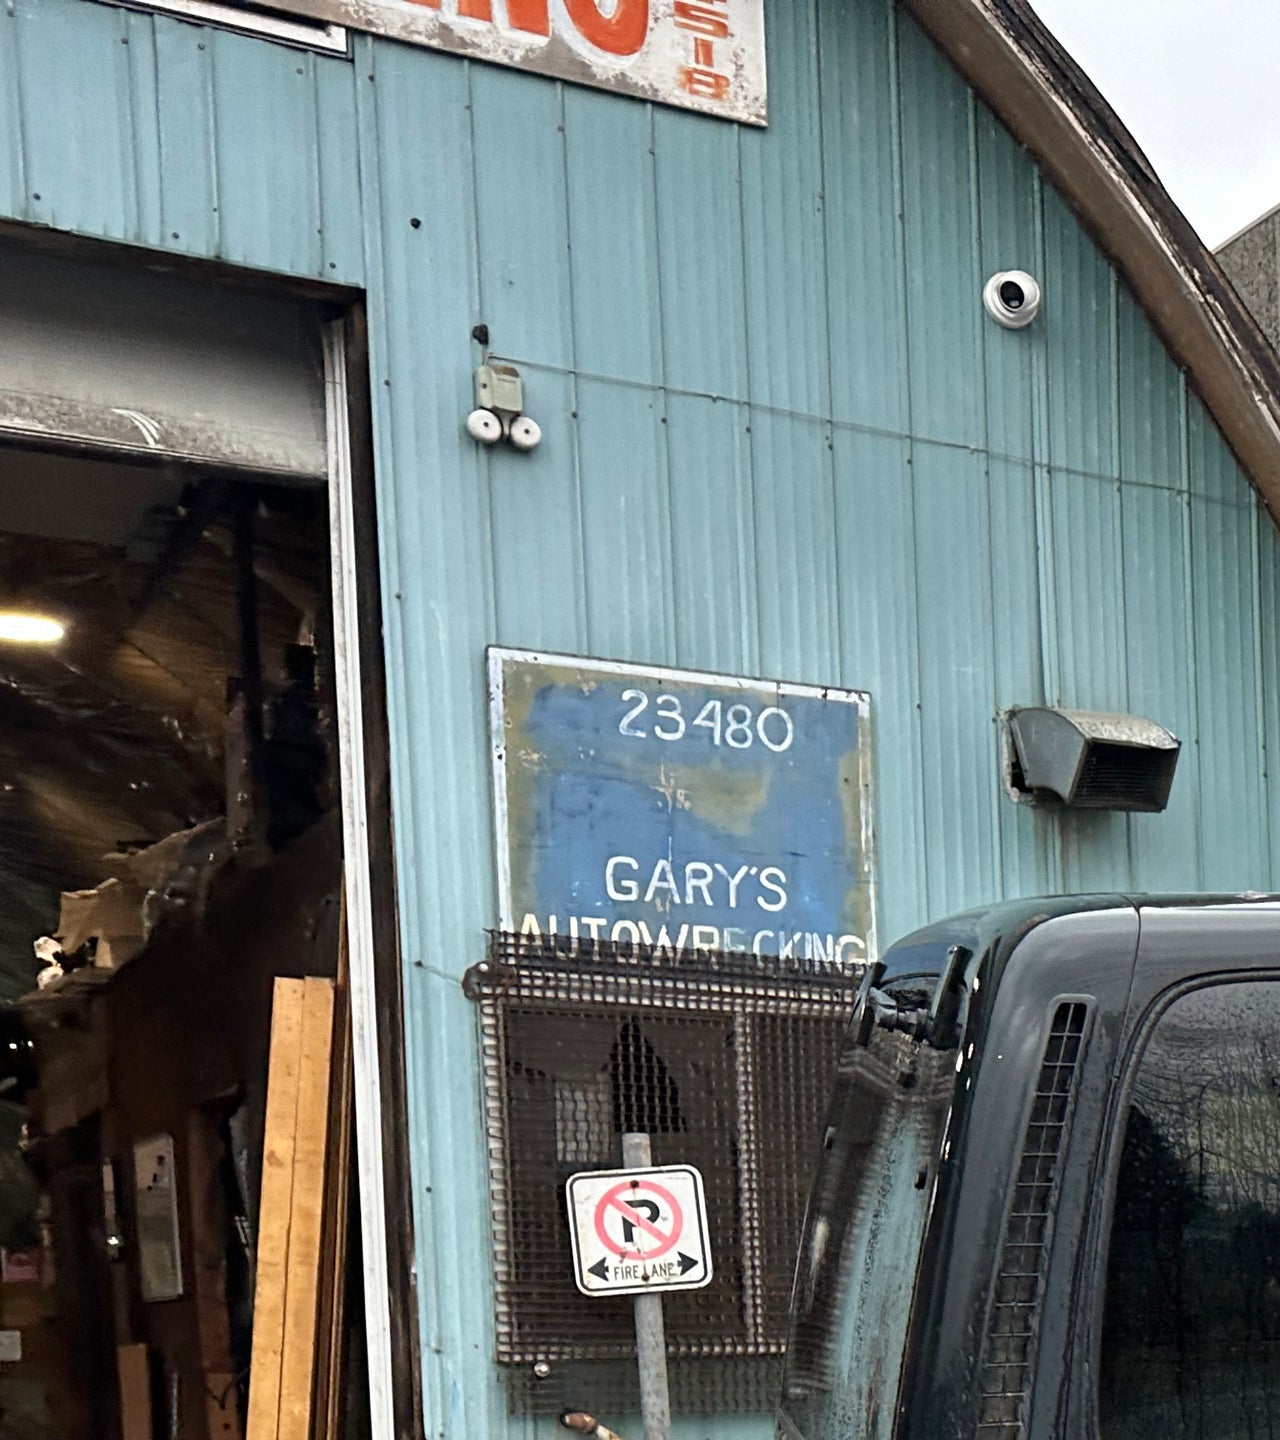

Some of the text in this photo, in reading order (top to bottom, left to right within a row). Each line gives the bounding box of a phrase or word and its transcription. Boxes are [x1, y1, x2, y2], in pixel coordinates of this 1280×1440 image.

[618, 689, 795, 753] 23480
[605, 855, 788, 913] GARY'S
[613, 1264, 640, 1281] FIRE
